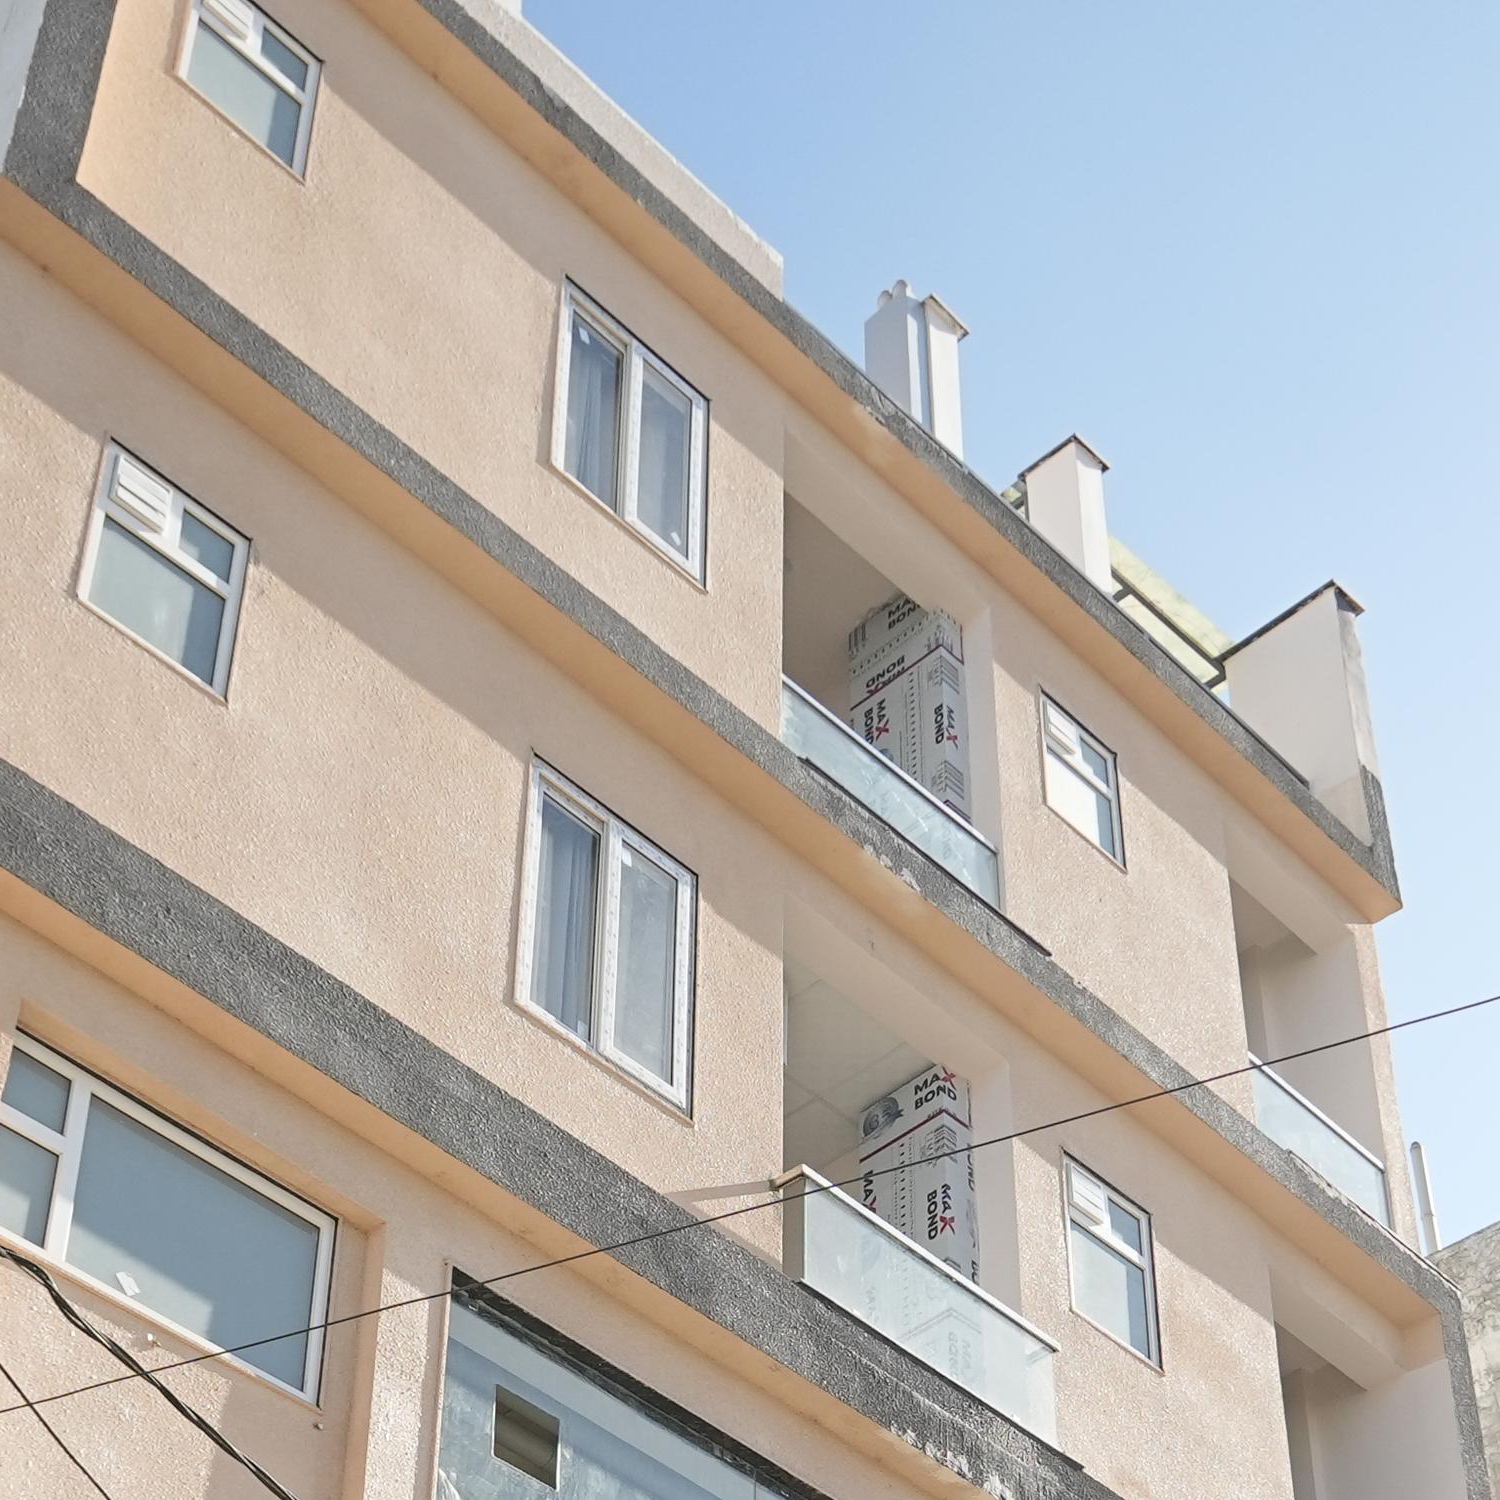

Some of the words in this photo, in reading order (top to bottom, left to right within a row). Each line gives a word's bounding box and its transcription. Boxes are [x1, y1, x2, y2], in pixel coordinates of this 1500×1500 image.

[888, 598, 911, 620] MA
[888, 602, 916, 630] BON
[877, 698, 889, 741] MAX
[934, 703, 944, 744] BOND
[914, 1066, 957, 1096] MAX
[914, 1085, 957, 1111] BOND
[927, 1189, 939, 1241] BOND
[941, 1183, 956, 1235] MAX
